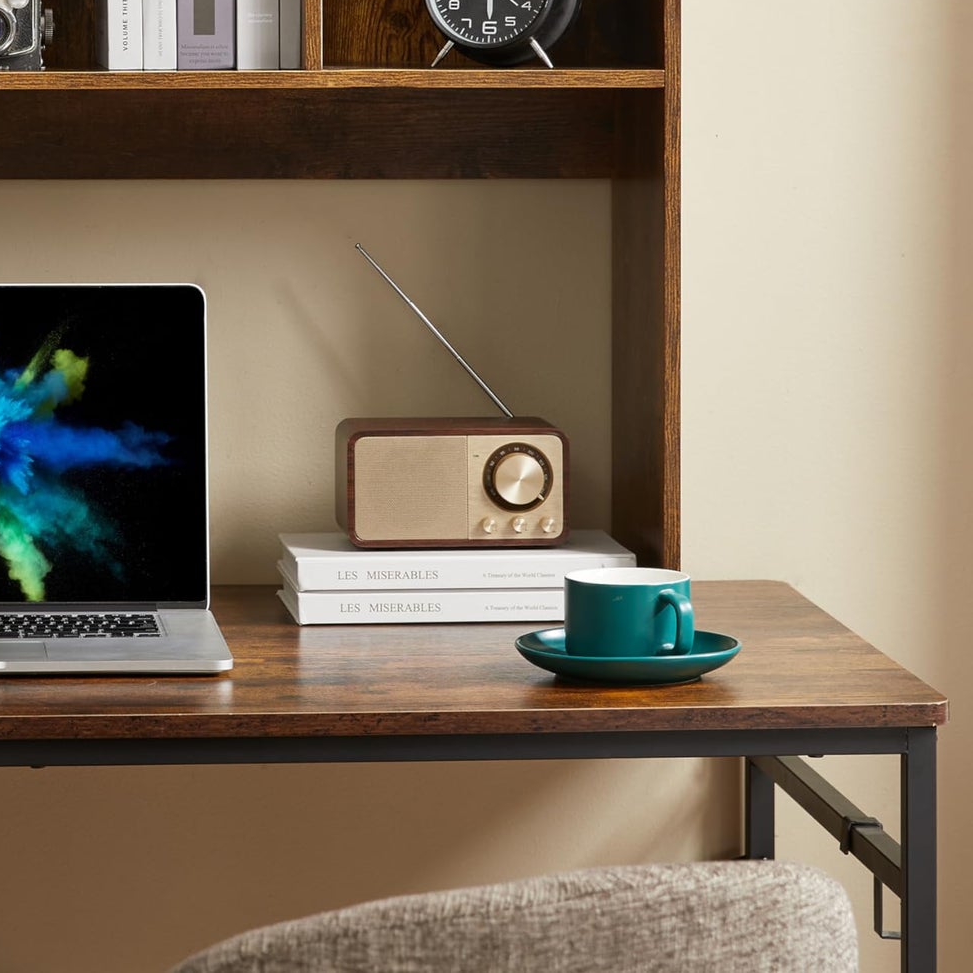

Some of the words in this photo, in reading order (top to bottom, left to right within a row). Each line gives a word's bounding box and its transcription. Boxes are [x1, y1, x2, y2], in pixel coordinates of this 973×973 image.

[448, 0, 460, 10] 8
[521, 1, 532, 11] 4
[461, 18, 472, 29] 7
[505, 16, 516, 27] 5
[482, 21, 497, 35] 6
[337, 570, 358, 580] LES
[367, 569, 439, 580] MISERABLES
[340, 603, 361, 613] LES
[369, 602, 441, 613] MISERABLES
